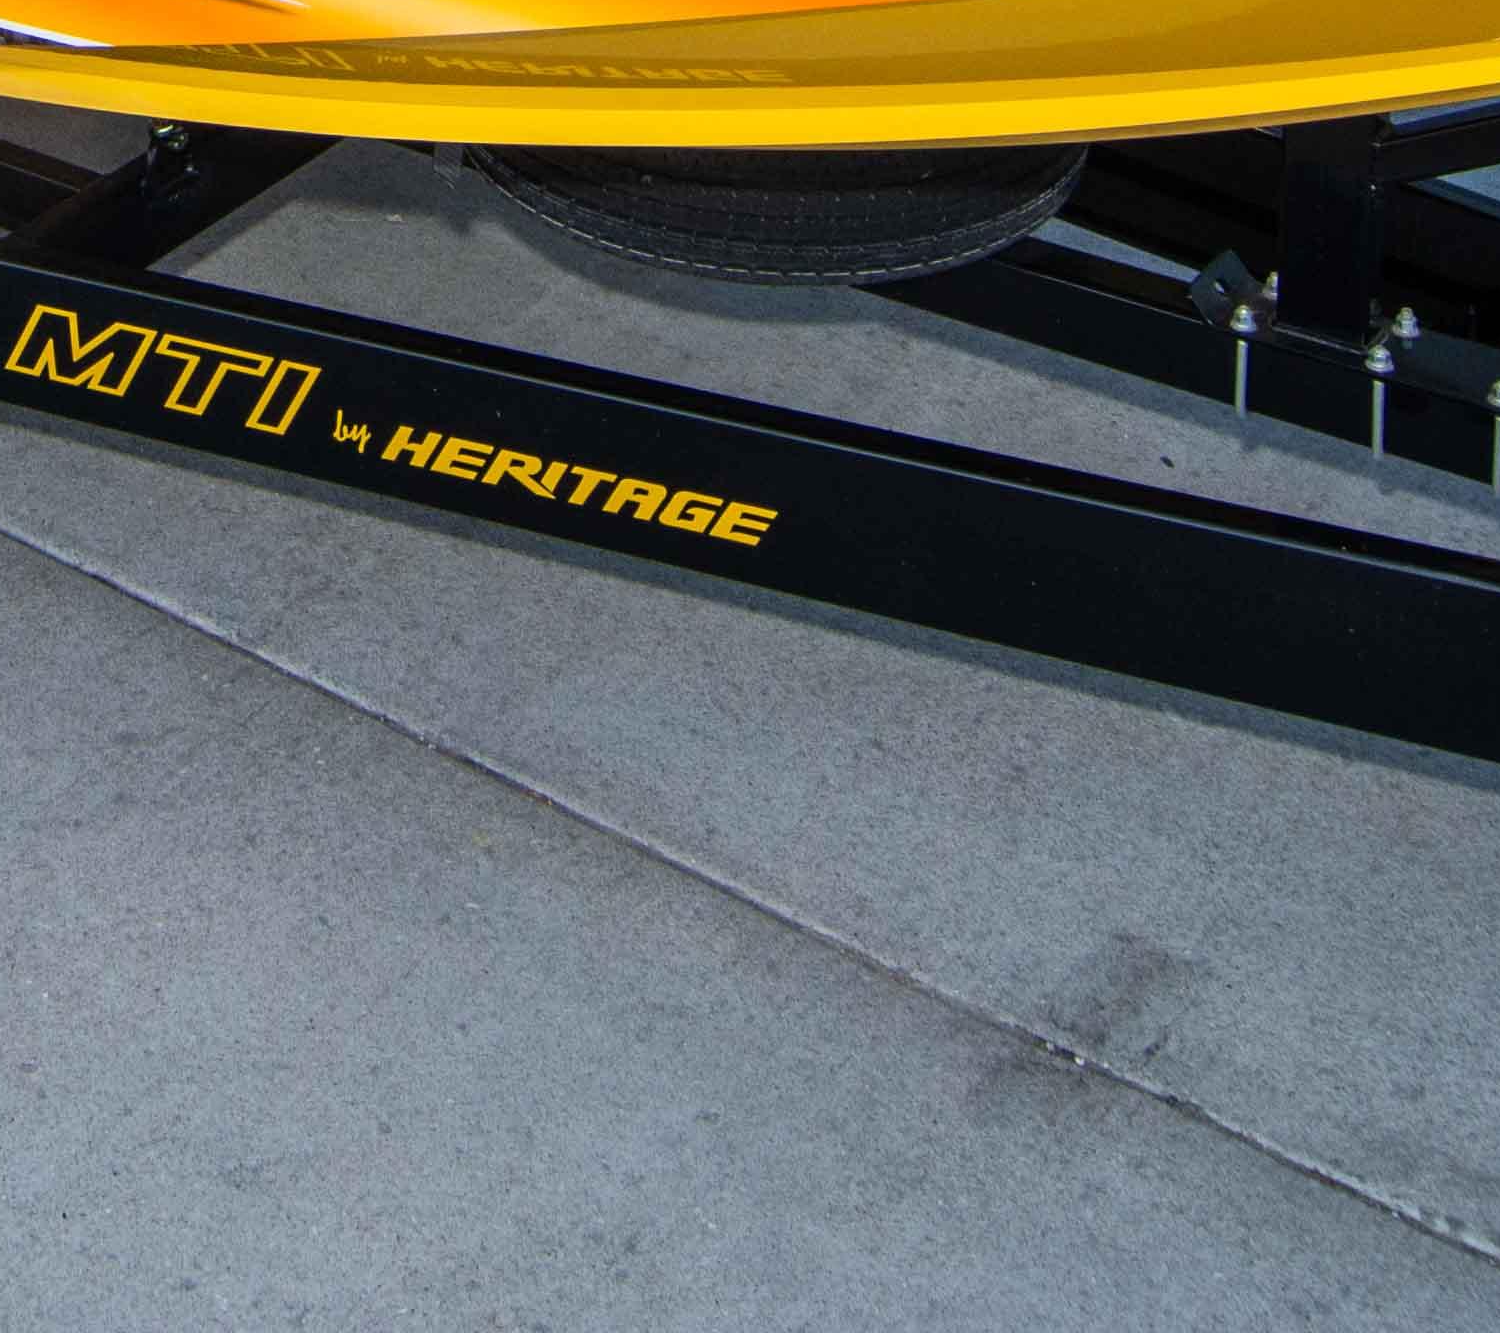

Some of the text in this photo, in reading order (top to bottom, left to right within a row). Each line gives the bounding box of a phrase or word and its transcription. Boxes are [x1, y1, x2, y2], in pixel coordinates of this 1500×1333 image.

[5, 304, 777, 545] MTI by HERITAGE
